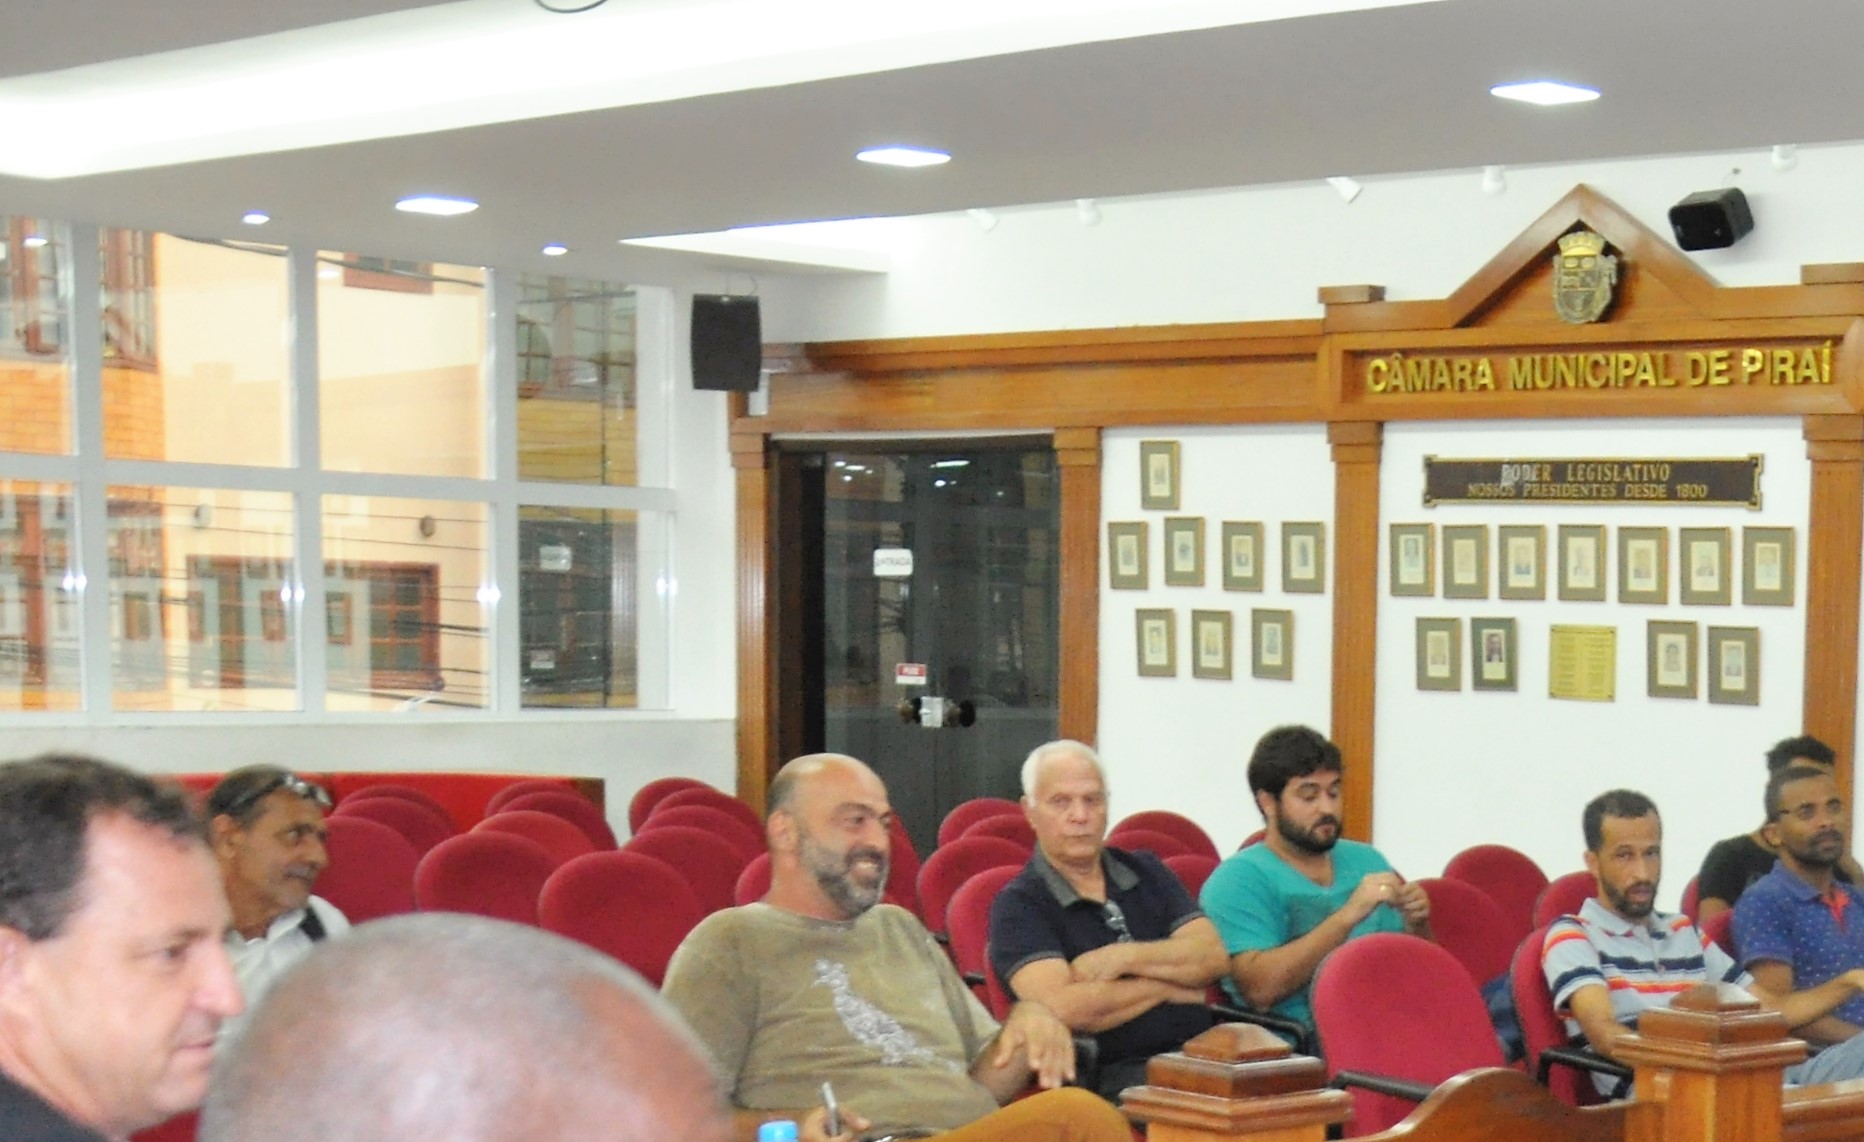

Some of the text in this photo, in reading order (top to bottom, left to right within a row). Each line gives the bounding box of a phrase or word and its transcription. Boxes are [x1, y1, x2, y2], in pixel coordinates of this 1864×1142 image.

[1367, 341, 1834, 393] CÂMARA MUNICIPAL DE PIRAÍ
[1501, 464, 1669, 482] PODER LEGISLATIVO
[1523, 484, 1616, 498] PRESIDENTES
[1625, 484, 1667, 498] DESDE
[1676, 484, 1708, 499] 1800
